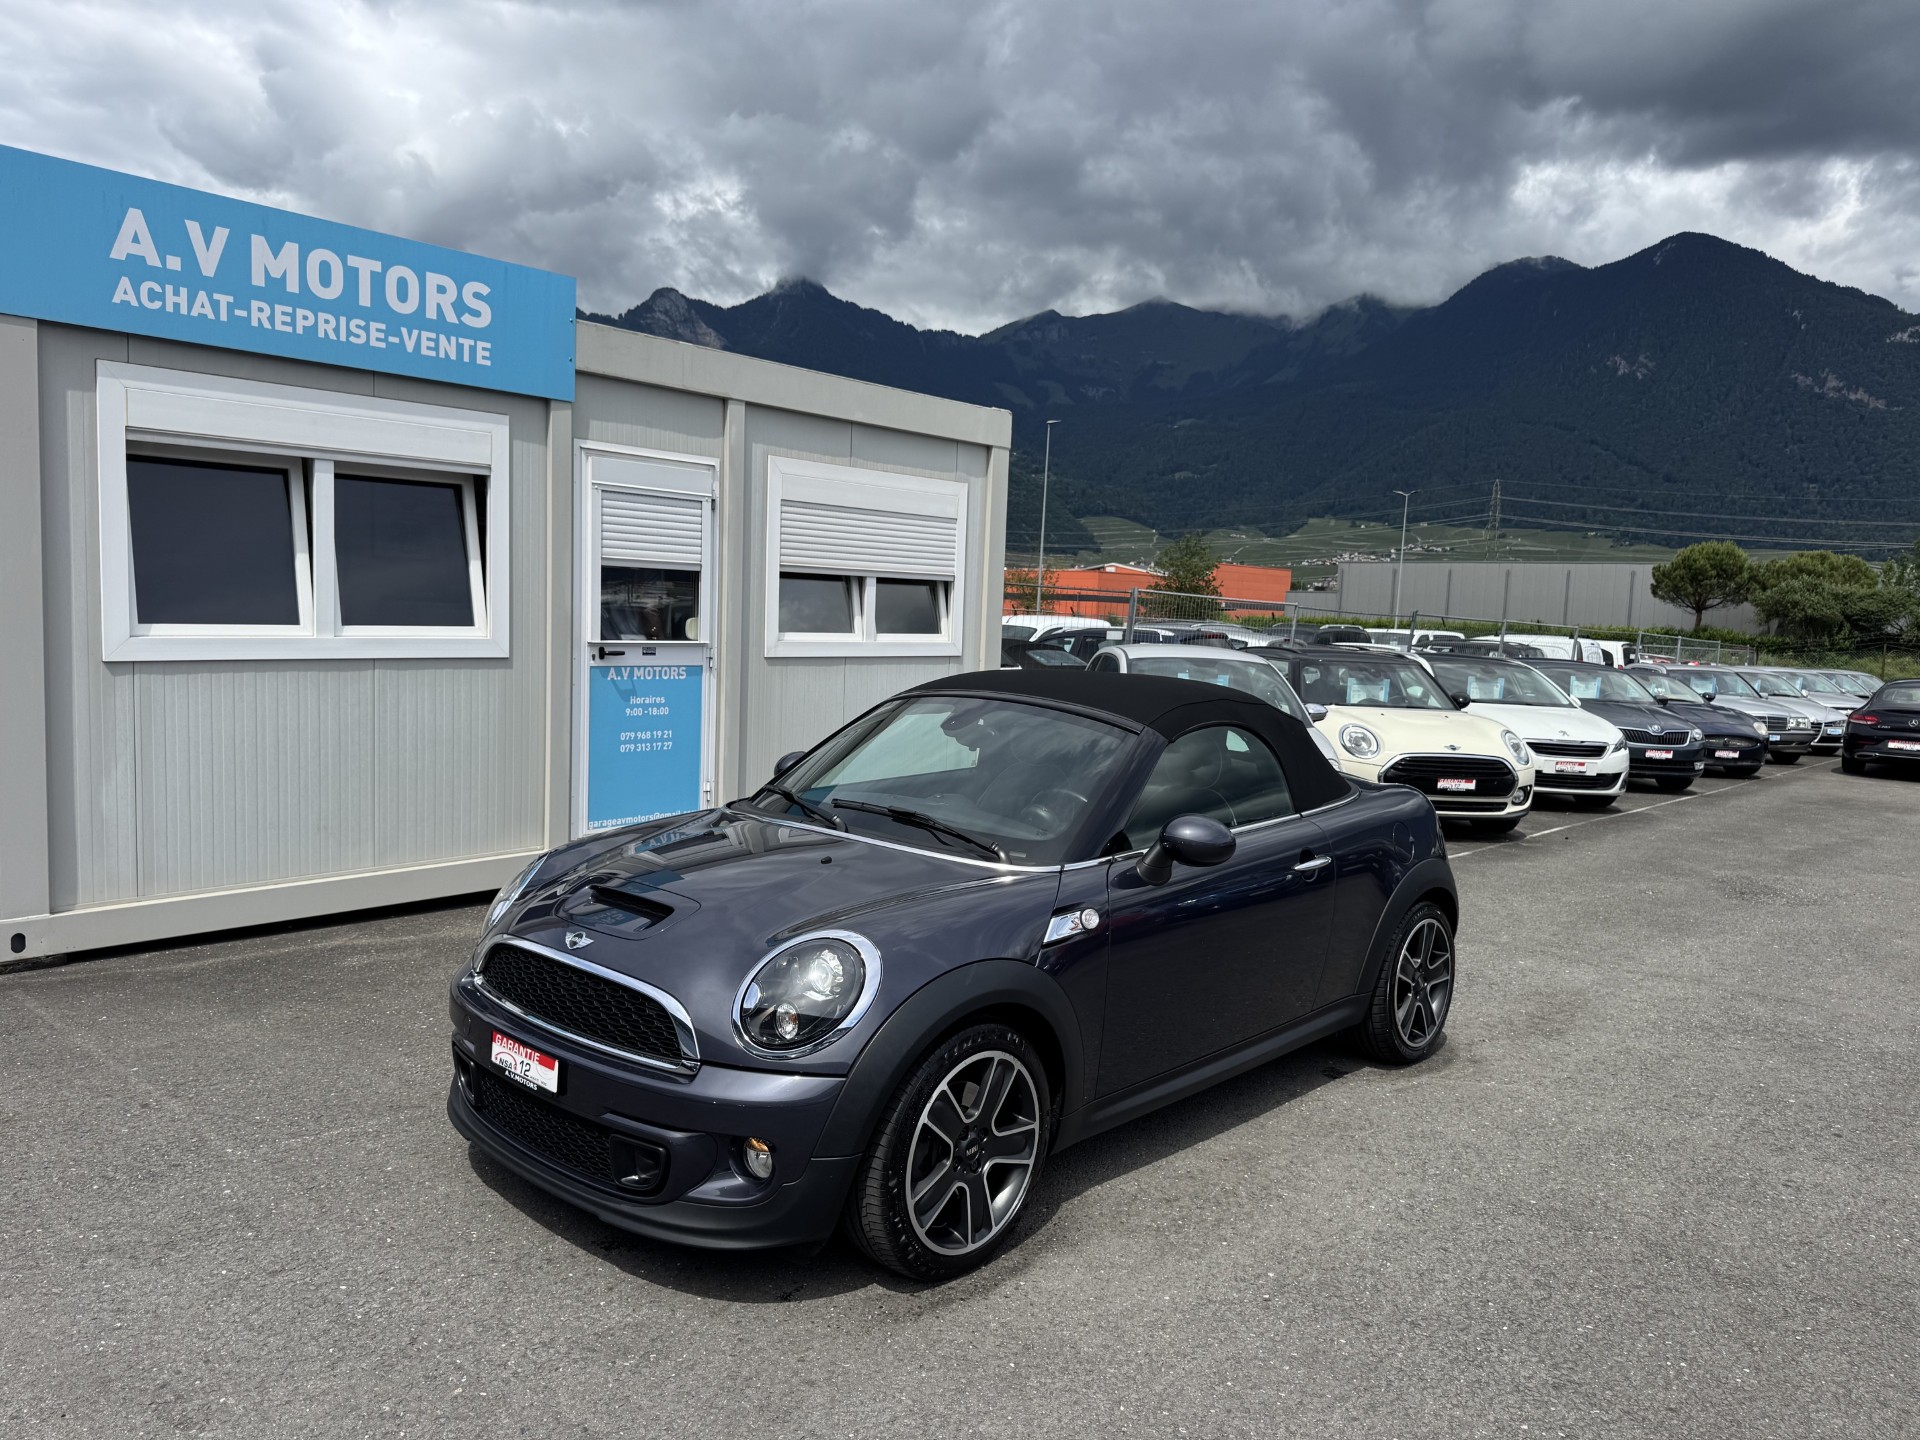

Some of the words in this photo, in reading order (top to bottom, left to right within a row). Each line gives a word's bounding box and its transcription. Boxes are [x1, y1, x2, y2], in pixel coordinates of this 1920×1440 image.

[109, 207, 230, 277] A.V
[250, 233, 492, 328] MOTORS
[111, 276, 492, 366] ACHAT-REPRISE-VENTE
[607, 667, 630, 680] A.V
[633, 666, 687, 680] MOTORS
[630, 695, 666, 704] Horaires
[625, 707, 643, 716] 9:00
[620, 732, 635, 741] 079
[636, 731, 651, 740] 968
[652, 730, 662, 739] 19
[663, 730, 673, 738] 21
[620, 744, 635, 753] 079
[636, 743, 651, 752] 313
[652, 742, 662, 751] 17
[663, 741, 673, 750] 27
[495, 1034, 541, 1064] GARANTIE
[498, 1057, 513, 1070] NSA
[519, 1060, 531, 1077] 12
